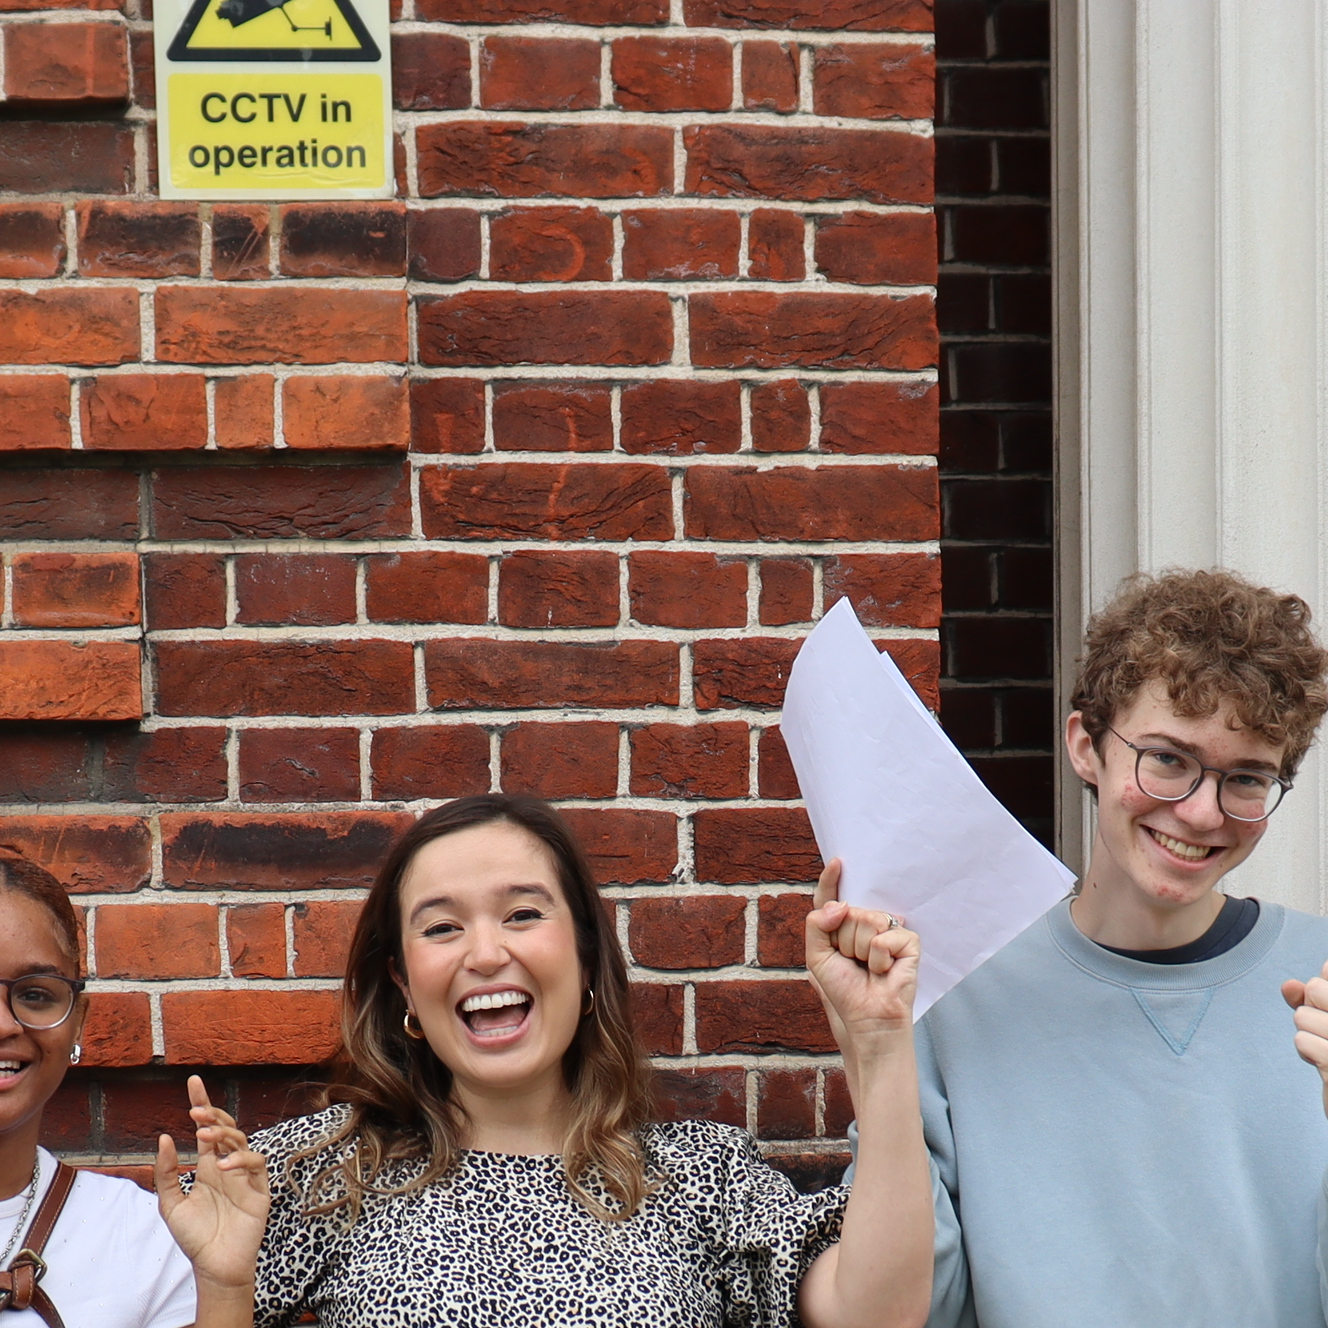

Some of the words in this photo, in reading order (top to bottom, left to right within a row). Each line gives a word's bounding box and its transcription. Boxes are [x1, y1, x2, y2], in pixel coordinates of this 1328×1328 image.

[200, 92, 306, 123] CCTV
[320, 93, 352, 122] in
[188, 138, 366, 175] operation
